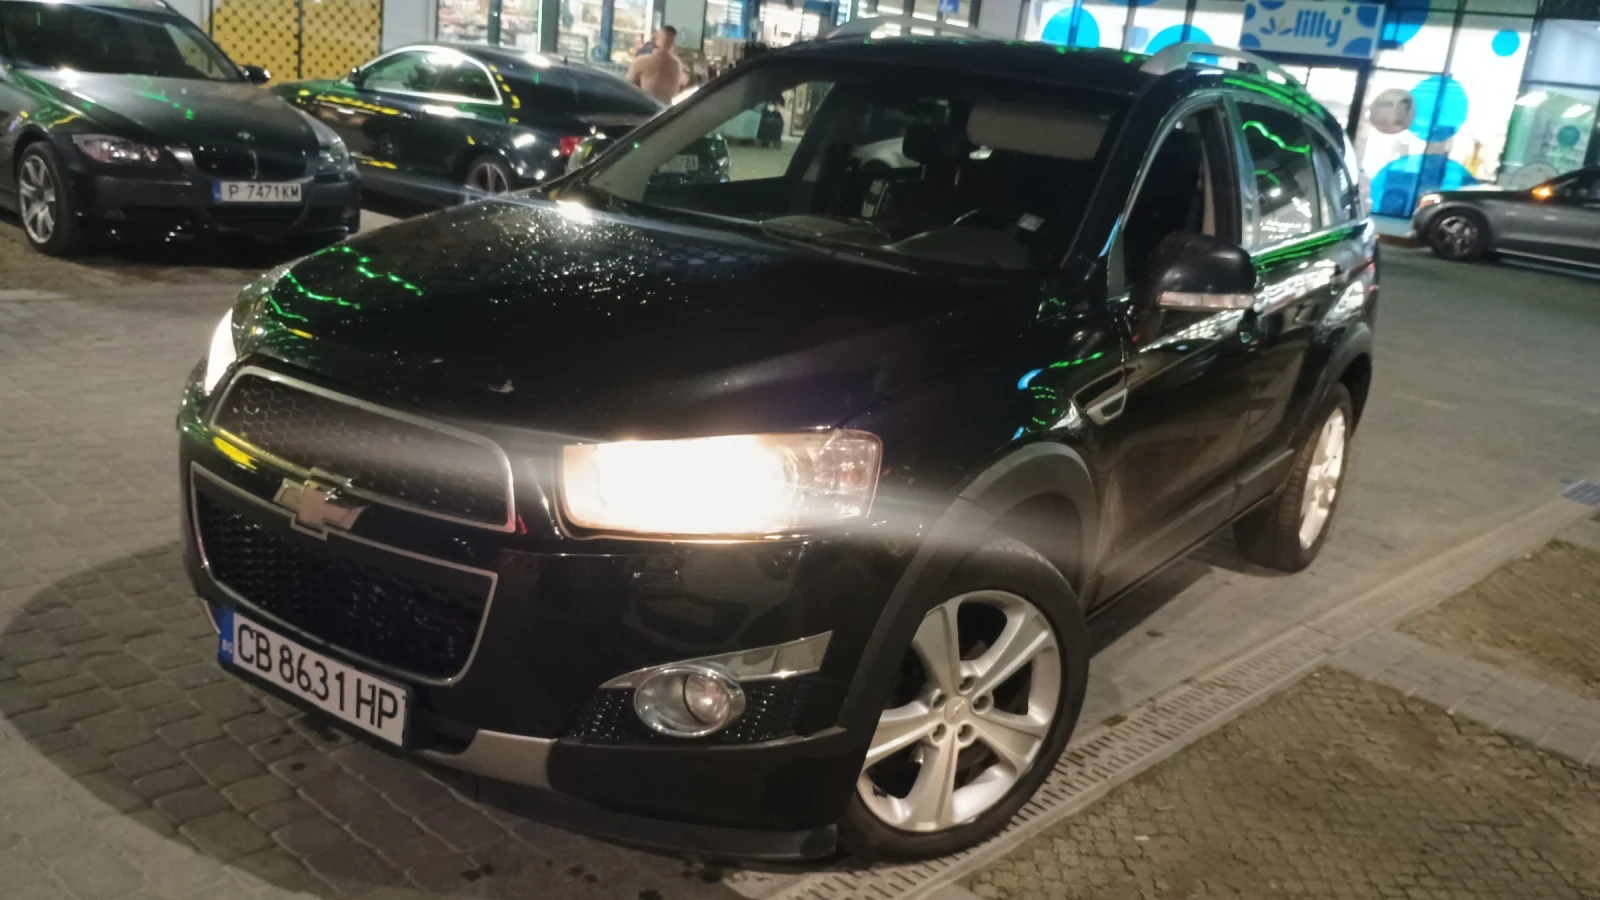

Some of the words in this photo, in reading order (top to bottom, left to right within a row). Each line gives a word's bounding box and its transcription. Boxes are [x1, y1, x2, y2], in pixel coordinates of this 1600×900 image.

[1294, 9, 1342, 48] lilly
[228, 184, 239, 199] P
[238, 623, 272, 673] CB
[279, 644, 345, 712] 8631
[355, 678, 399, 729] HP
